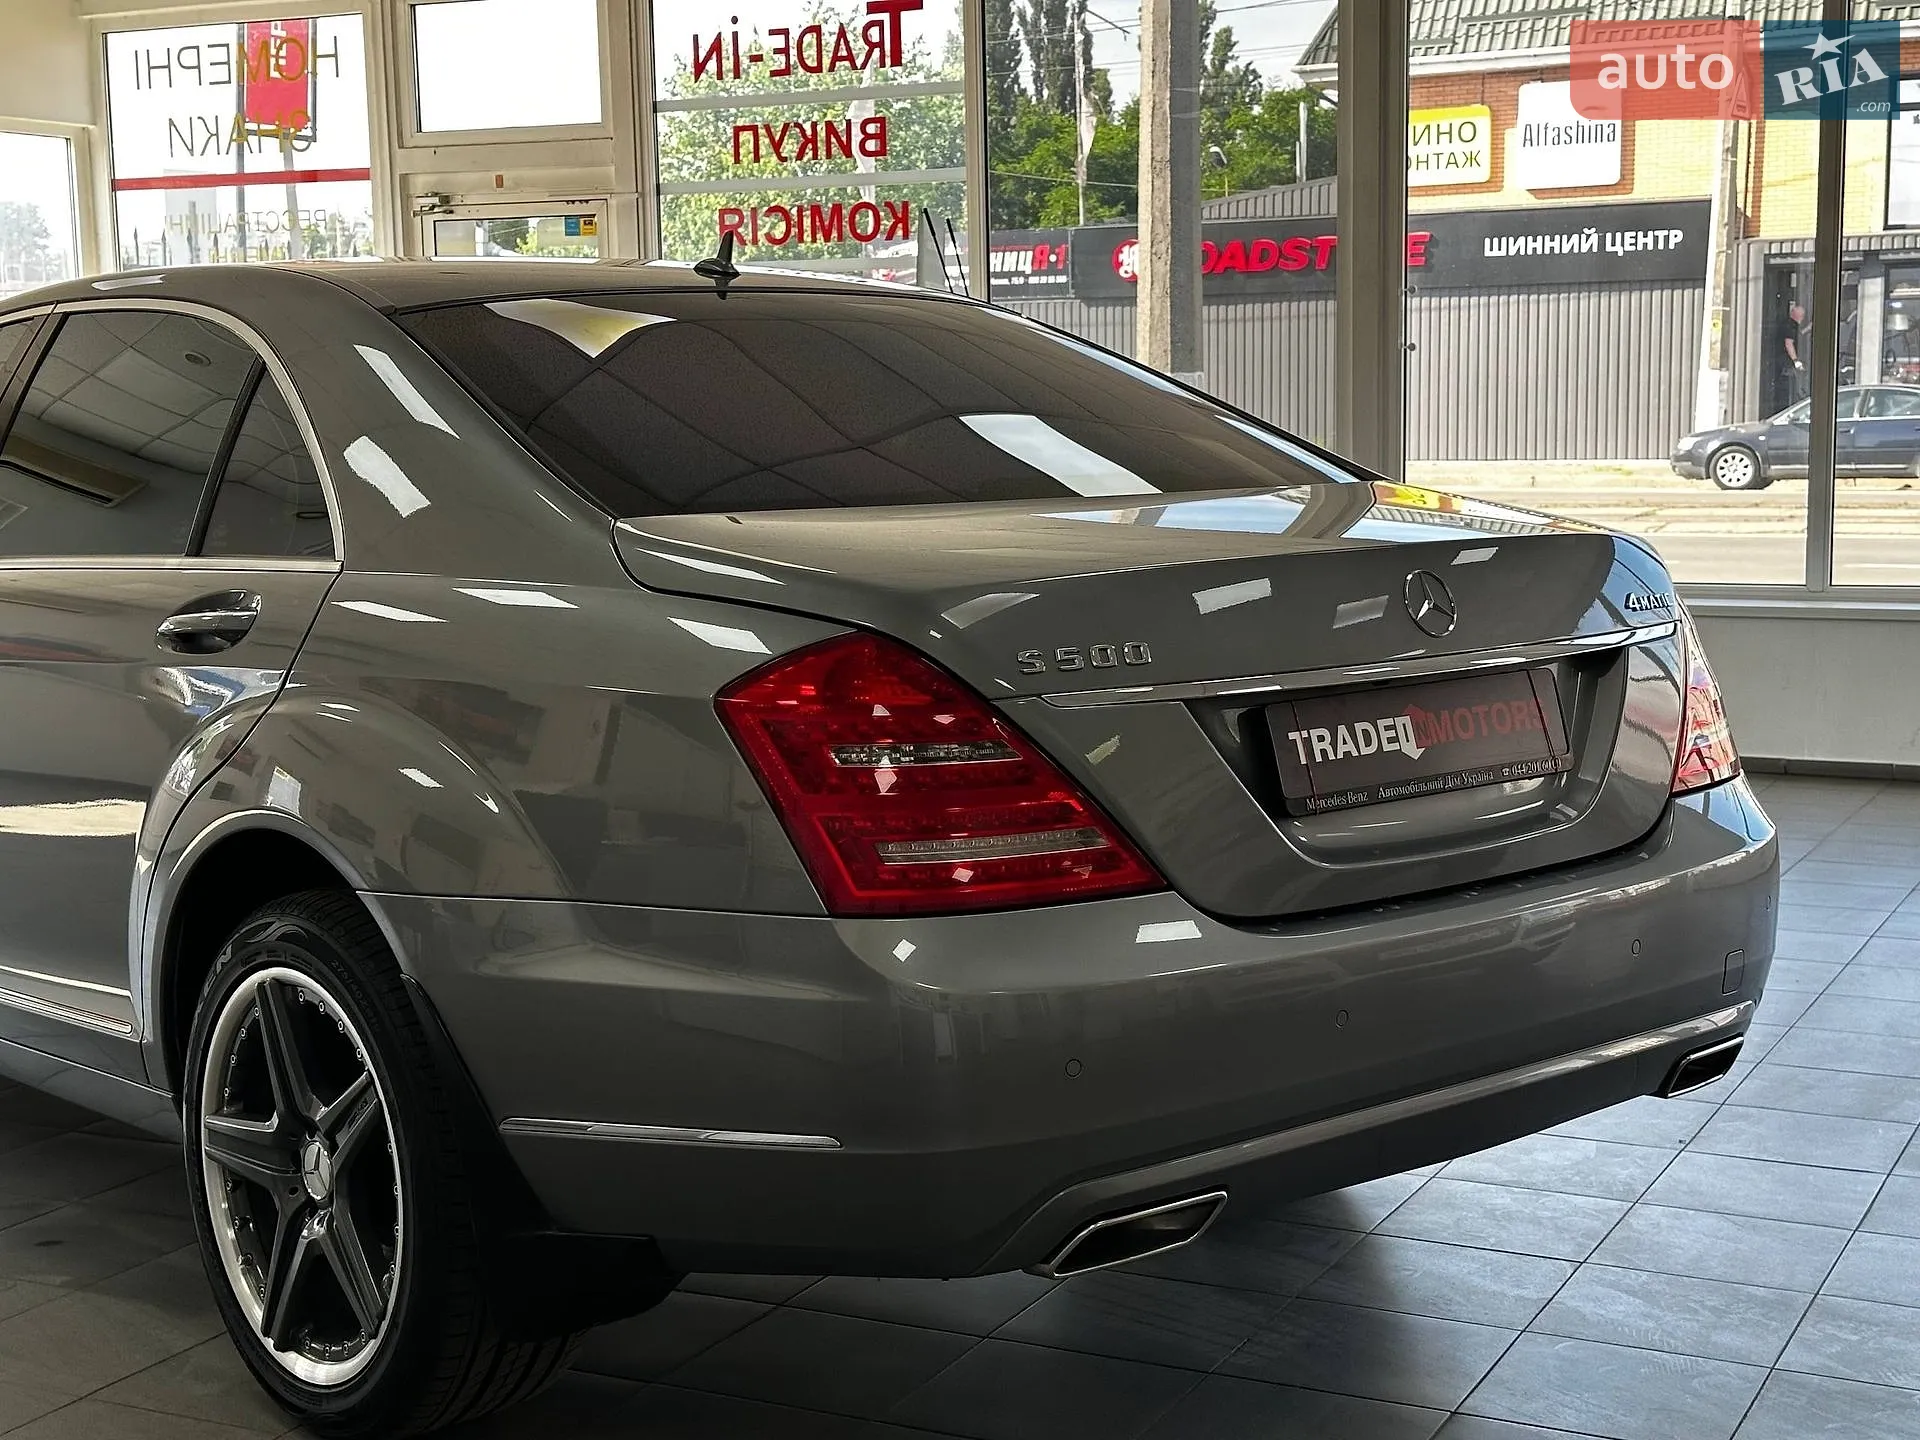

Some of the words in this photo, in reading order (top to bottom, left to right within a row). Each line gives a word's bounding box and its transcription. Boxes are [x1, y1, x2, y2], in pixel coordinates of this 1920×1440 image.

[1412, 121, 1477, 147] ИНО
[1522, 119, 1616, 148] Alfashina
[1408, 150, 1481, 171] НТАЖ
[1483, 228, 1598, 258] ШИННИЙ
[1604, 229, 1684, 257] ЦЕНТР
[1624, 592, 1674, 613] 4MATIC
